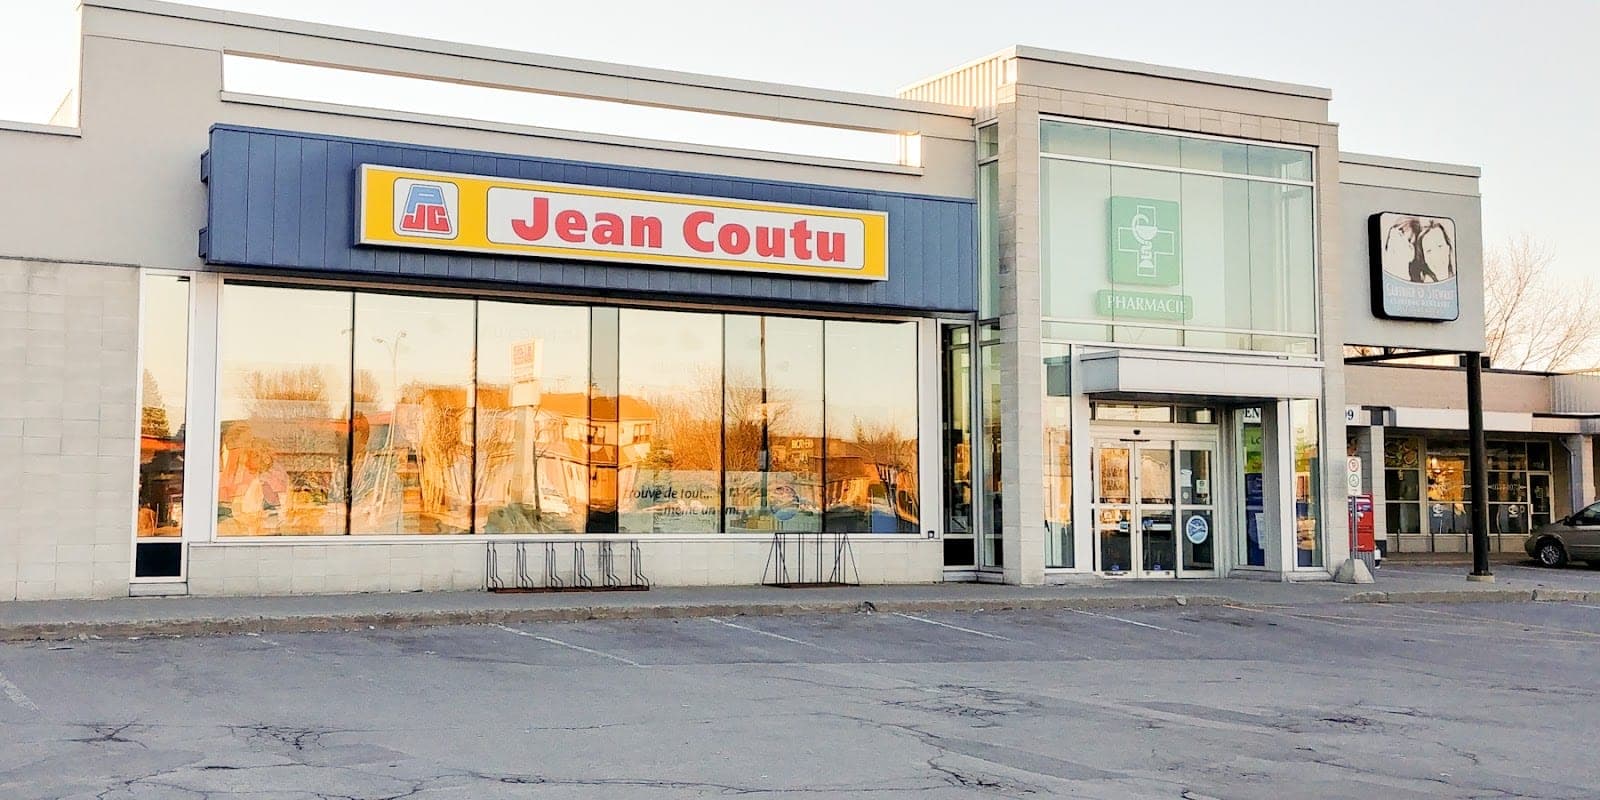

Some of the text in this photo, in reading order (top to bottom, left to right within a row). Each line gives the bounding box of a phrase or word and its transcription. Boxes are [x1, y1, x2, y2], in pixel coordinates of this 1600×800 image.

[511, 197, 846, 263] Jean Coutu
[1345, 409, 1354, 421] 9
[664, 486, 678, 499] de
